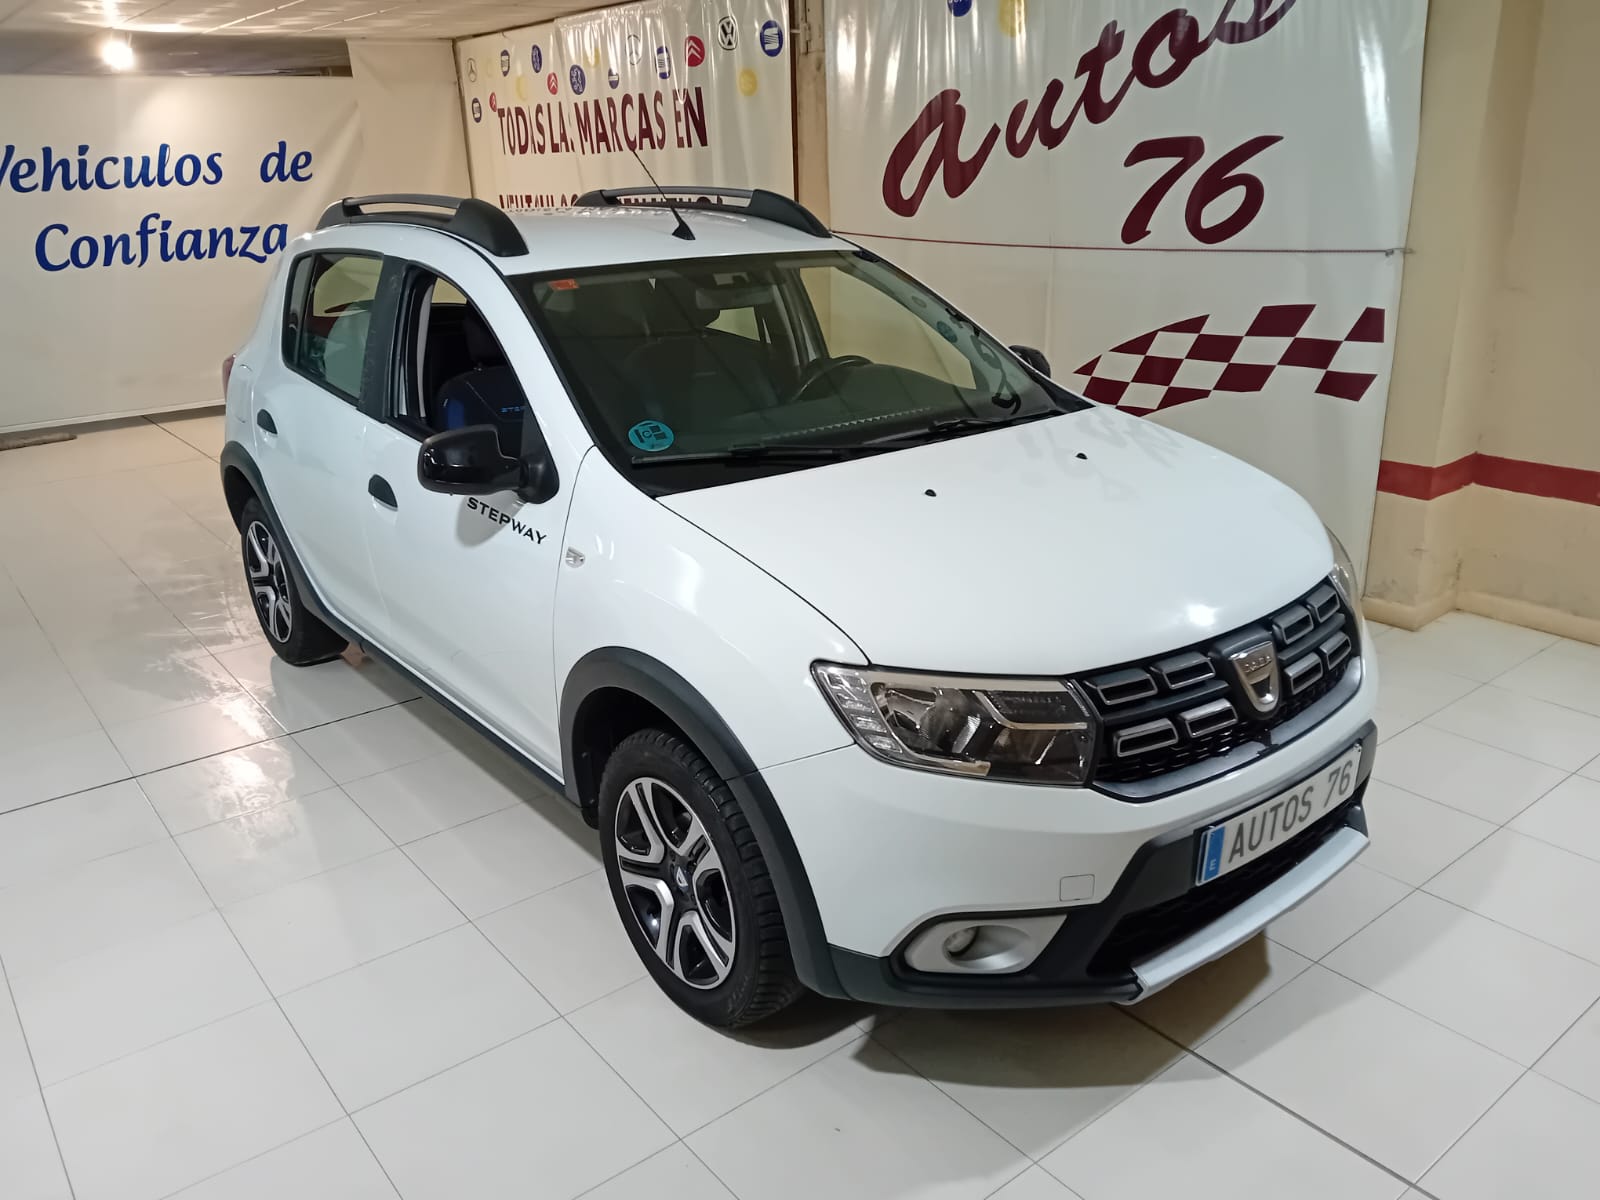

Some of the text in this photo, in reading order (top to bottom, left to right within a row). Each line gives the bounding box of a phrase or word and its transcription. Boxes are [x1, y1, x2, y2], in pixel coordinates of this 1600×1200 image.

[574, 91, 666, 155] MARCAS
[673, 86, 708, 149] EN
[260, 141, 313, 183] de
[1121, 135, 1283, 244] 76
[35, 213, 288, 272] Confianza
[467, 496, 547, 545] STEPWAY
[1228, 760, 1353, 863] AUTOS 76
